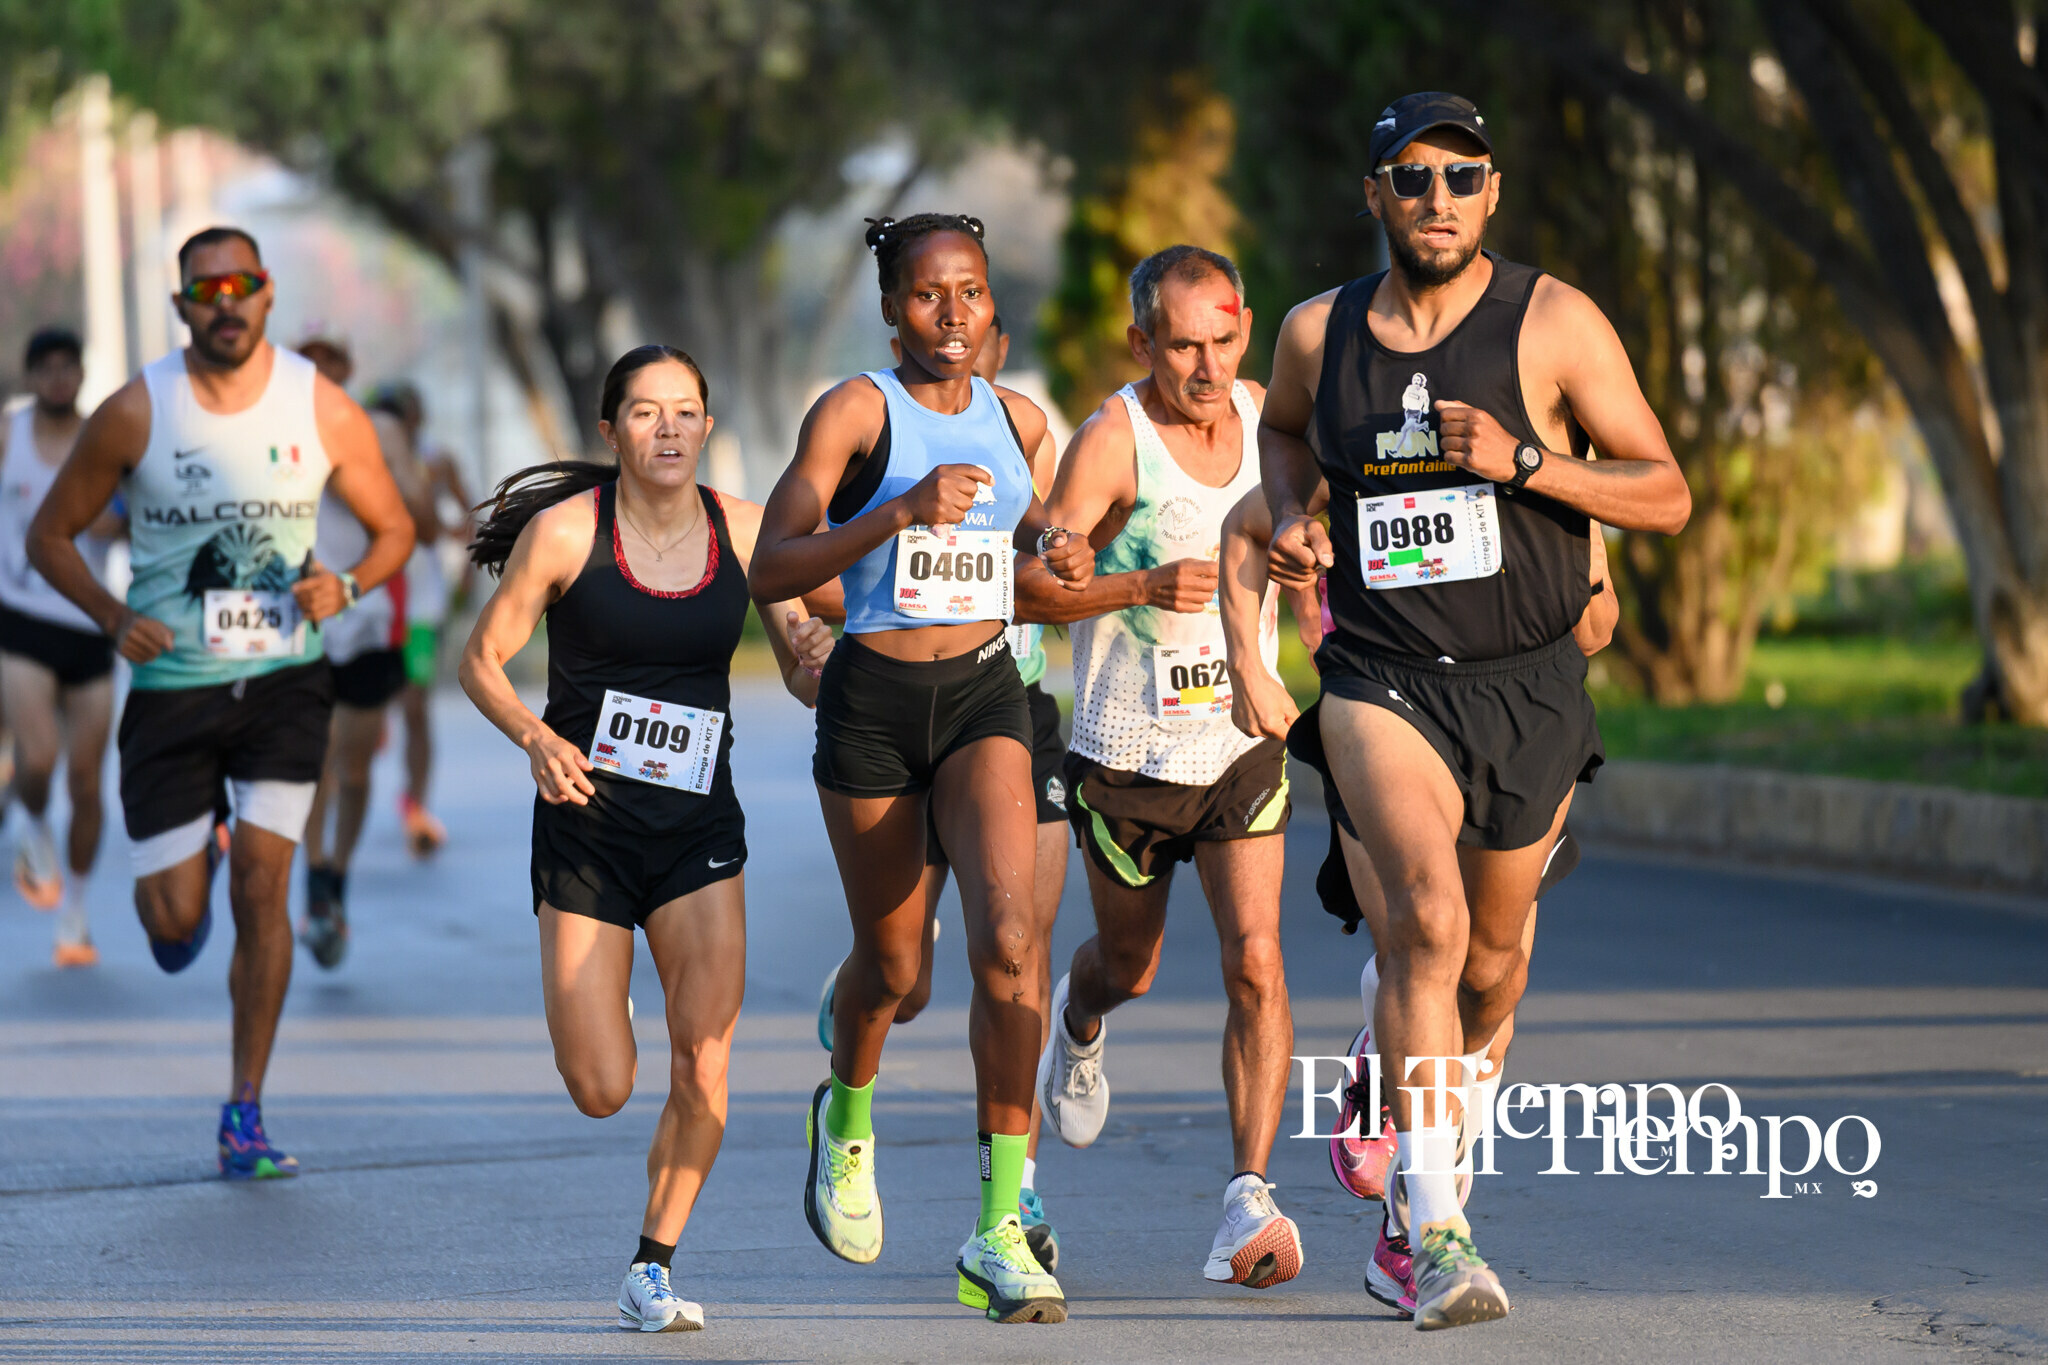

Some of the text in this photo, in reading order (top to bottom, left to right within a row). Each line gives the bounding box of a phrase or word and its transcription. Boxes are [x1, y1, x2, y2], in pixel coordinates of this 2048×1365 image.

[144, 500, 316, 525] HALCONE
[1157, 499, 1174, 516] REBEL
[964, 512, 994, 526] WAI
[1161, 529, 1176, 541] TRAIL
[1370, 512, 1454, 551] 0988
[1475, 504, 1491, 571] Entrega de KIT
[910, 551, 993, 582] 0460
[1002, 567, 1007, 577] de
[1368, 559, 1385, 571] 10K
[899, 588, 917, 599] 10K
[218, 607, 281, 630] 0425
[977, 633, 1005, 664] NIKE
[1170, 659, 1228, 691] 062
[1162, 697, 1179, 707] 10K
[609, 712, 690, 753] 0109
[705, 727, 714, 741] KIT
[596, 742, 614, 755] 10K
[702, 744, 711, 754] de
[594, 755, 621, 766] SIMSA
[696, 757, 708, 789] Entrega
